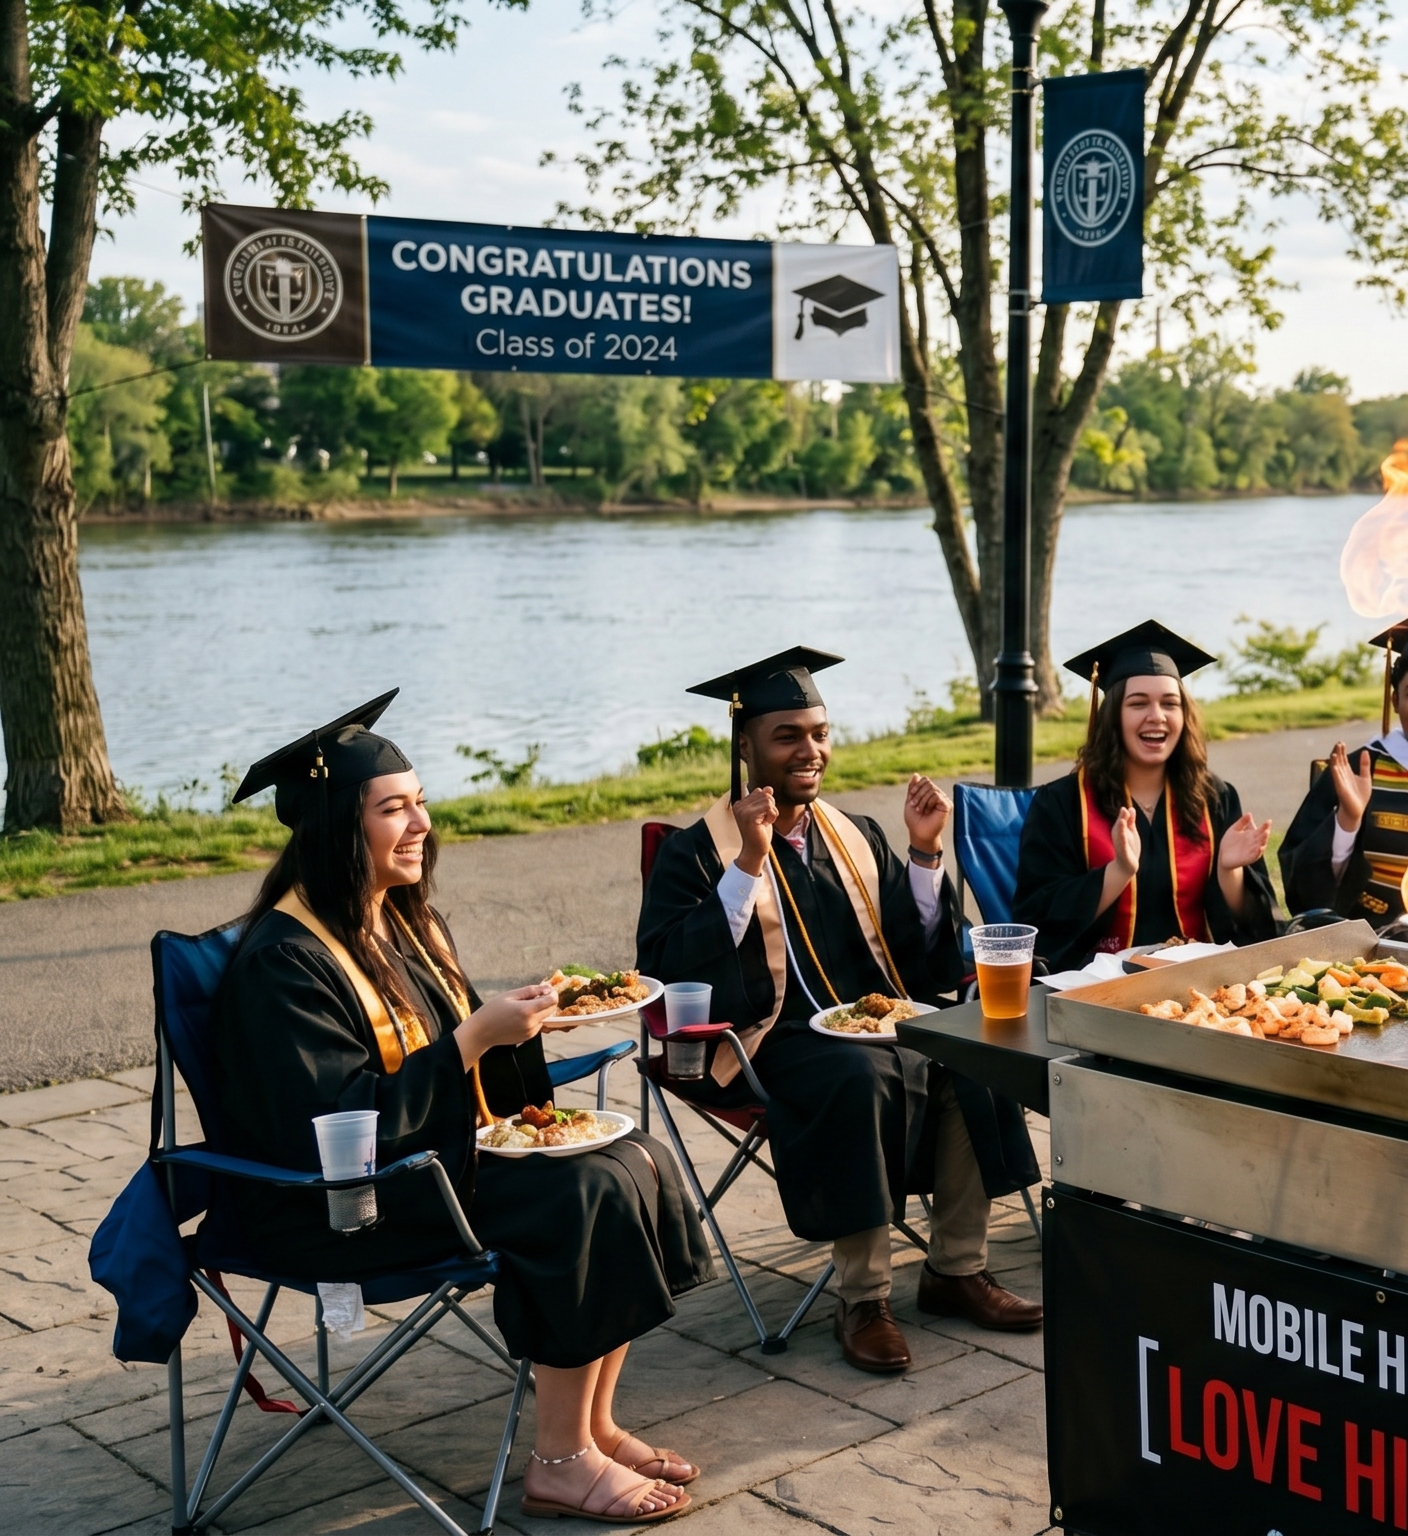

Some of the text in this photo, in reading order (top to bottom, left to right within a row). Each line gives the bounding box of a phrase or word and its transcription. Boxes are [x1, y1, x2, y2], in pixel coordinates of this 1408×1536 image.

[391, 240, 753, 290] CONGRATULATIONS
[460, 283, 692, 324] GRADUATES!
[475, 327, 678, 362] Class of 2024
[1213, 1282, 1365, 1383] MOBILE
